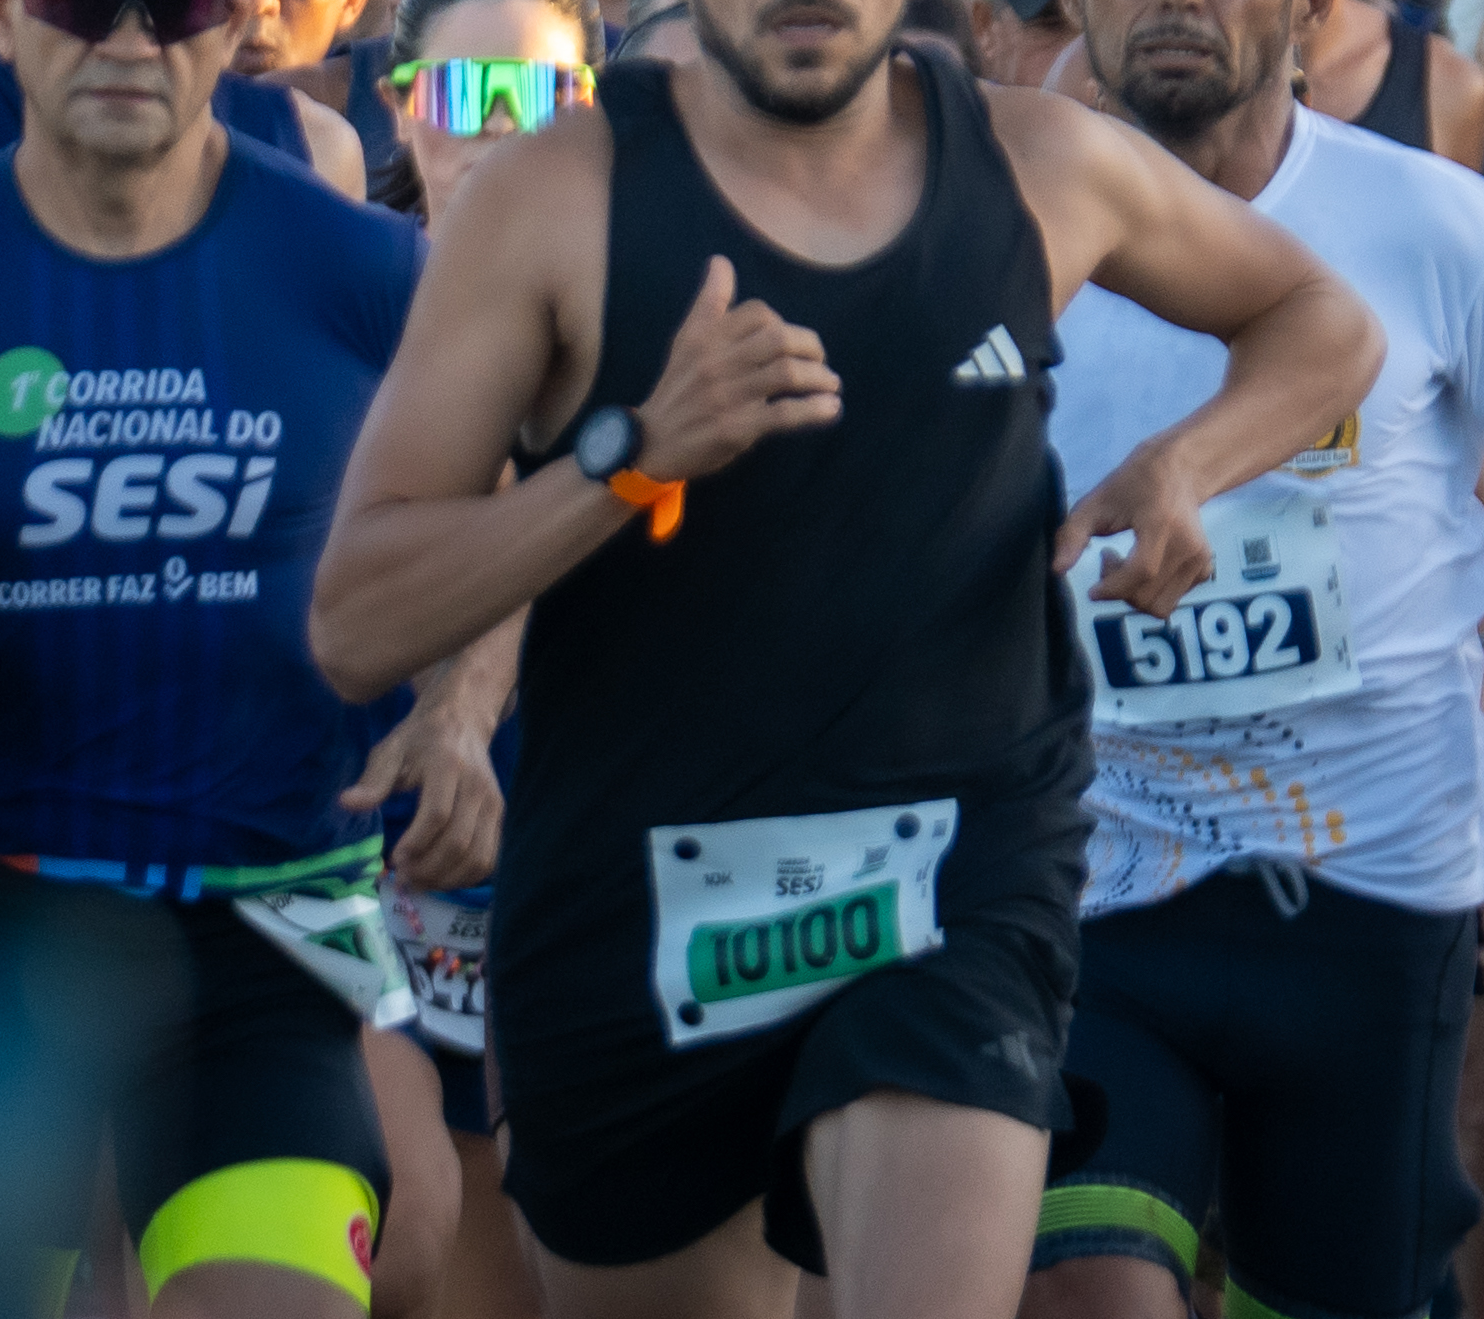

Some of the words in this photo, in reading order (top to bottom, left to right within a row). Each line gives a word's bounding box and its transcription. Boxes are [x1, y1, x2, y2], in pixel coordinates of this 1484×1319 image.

[45, 368, 206, 407] CORRIDA
[35, 409, 219, 452] NACIONAL
[226, 410, 283, 447] DO
[106, 573, 156, 604] FAZ
[197, 570, 258, 602] BEM
[1122, 593, 1302, 684] 5192
[710, 893, 882, 987] 10100
